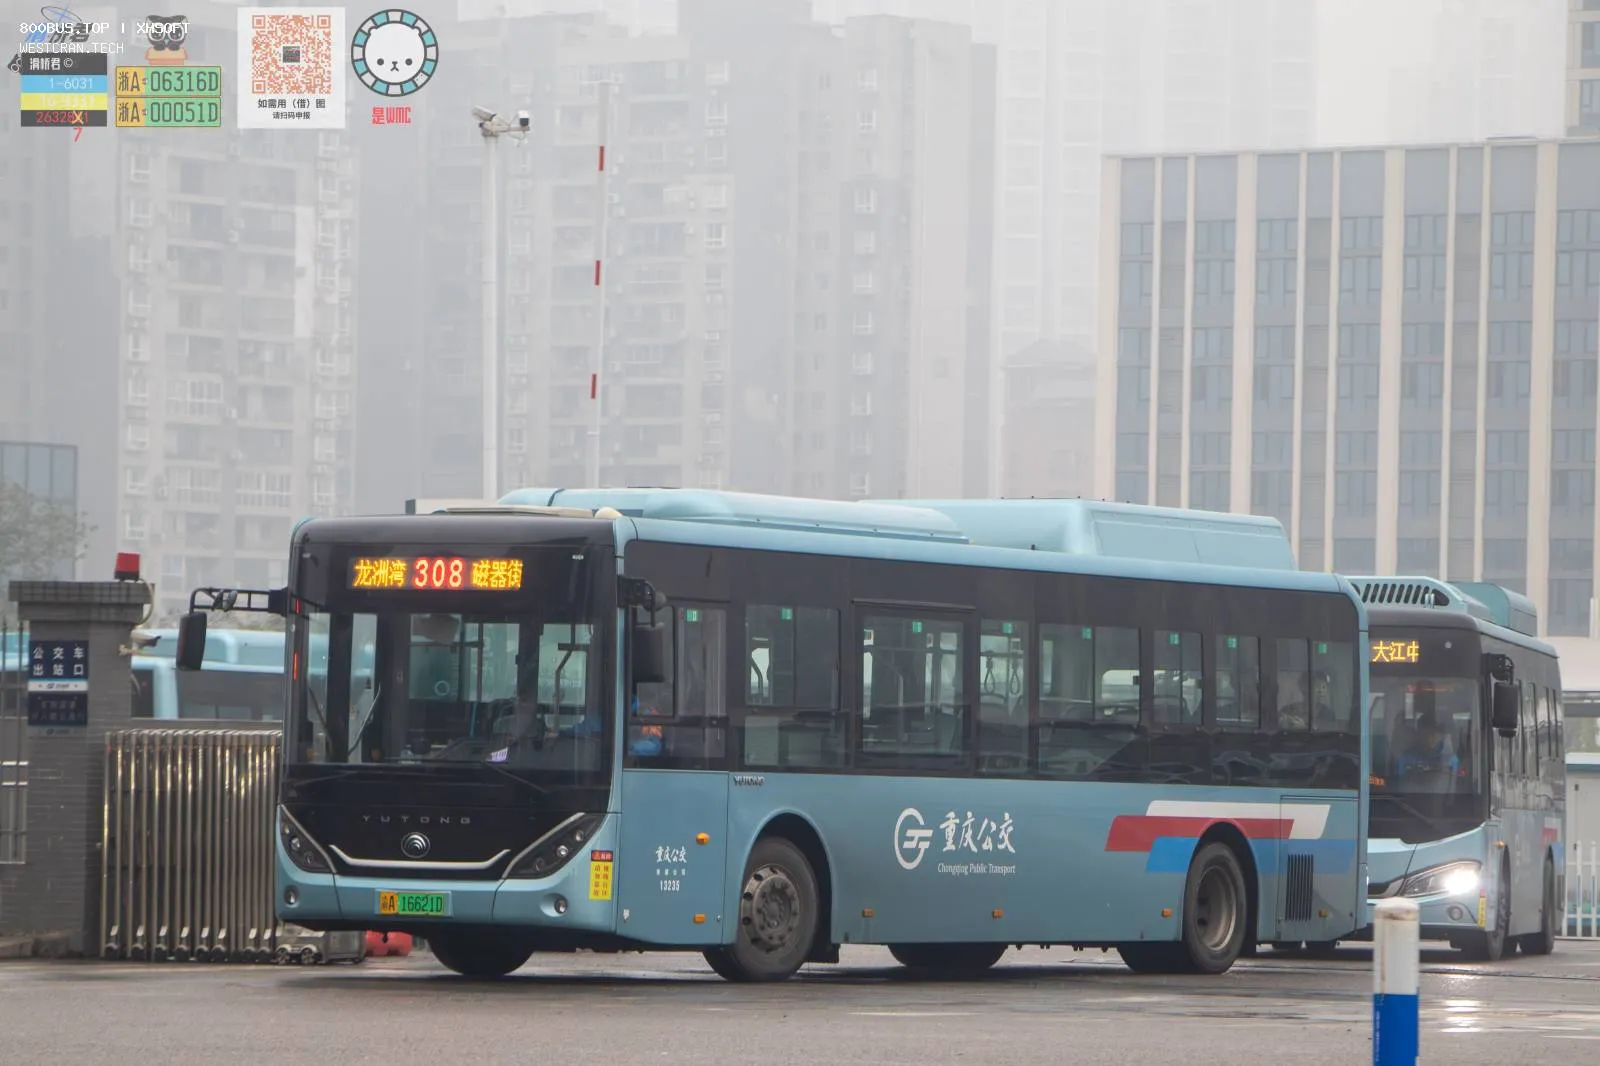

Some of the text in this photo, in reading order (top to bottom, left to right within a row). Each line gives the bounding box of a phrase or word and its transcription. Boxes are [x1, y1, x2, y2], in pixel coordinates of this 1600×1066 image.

[353, 558, 524, 589] 龙洲湾 308 磁器街
[33, 646, 85, 660] 公交车
[33, 663, 84, 676] 出站口
[362, 814, 472, 825] YUTONG
[939, 810, 1017, 854] 重庆公交
[937, 863, 1017, 876] Chongqing Public Transport
[659, 880, 681, 892] 13235
